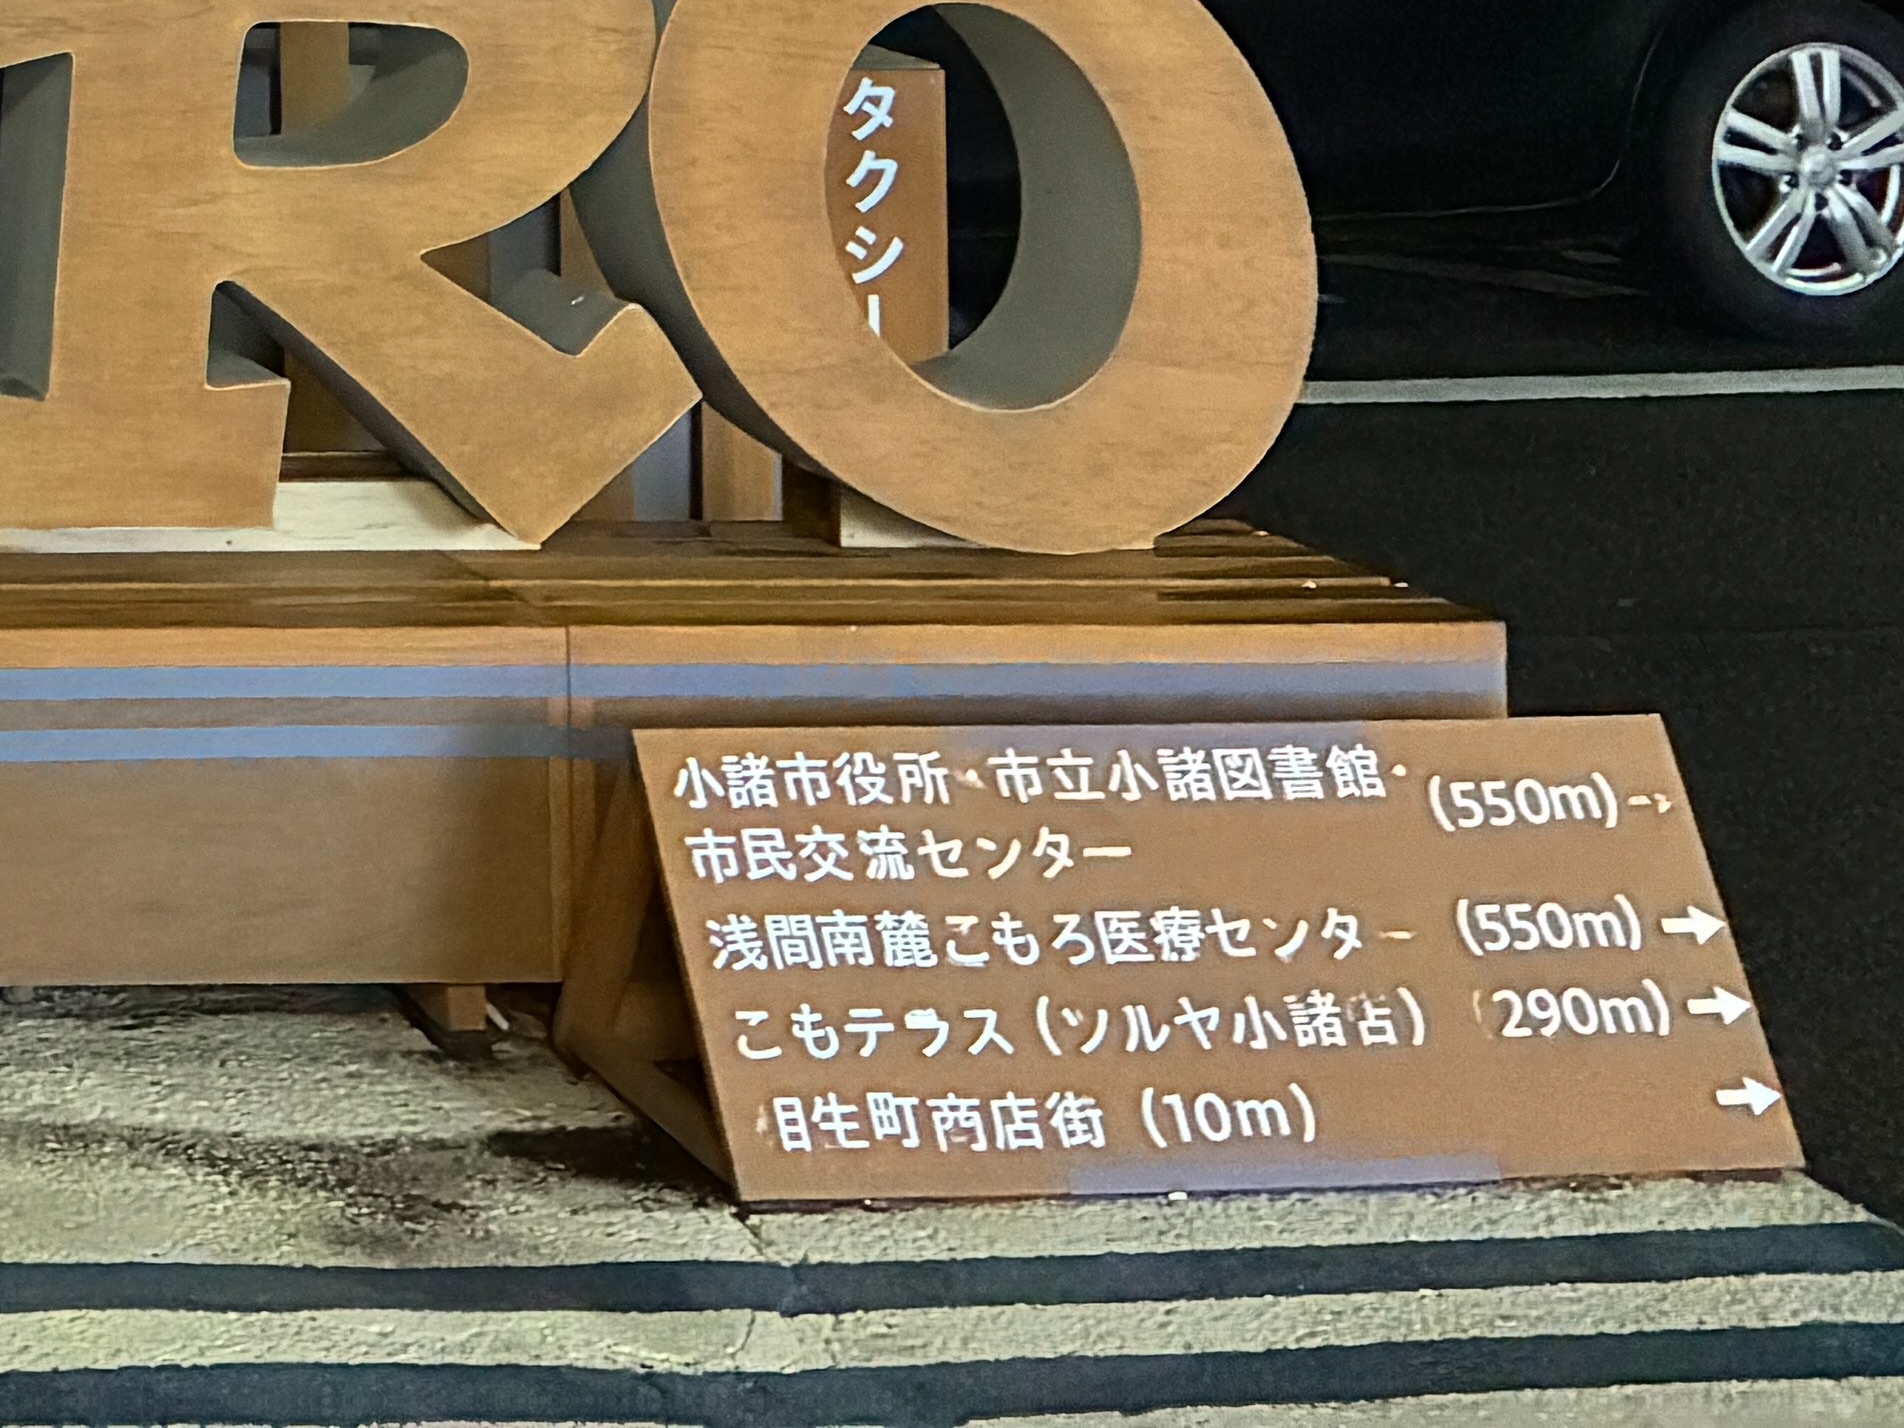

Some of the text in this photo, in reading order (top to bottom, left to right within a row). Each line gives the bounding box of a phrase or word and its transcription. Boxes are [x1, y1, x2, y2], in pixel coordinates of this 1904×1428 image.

[842, 76, 904, 338] タクシー
[1428, 771, 1618, 833] (550m)
[683, 822, 1133, 884] 市民交流センター
[705, 893, 1643, 971] 浅間南麓こもろ医療センター (550m)
[733, 1002, 1015, 1061] こもテラス
[1140, 1082, 1317, 1149] (10m)
